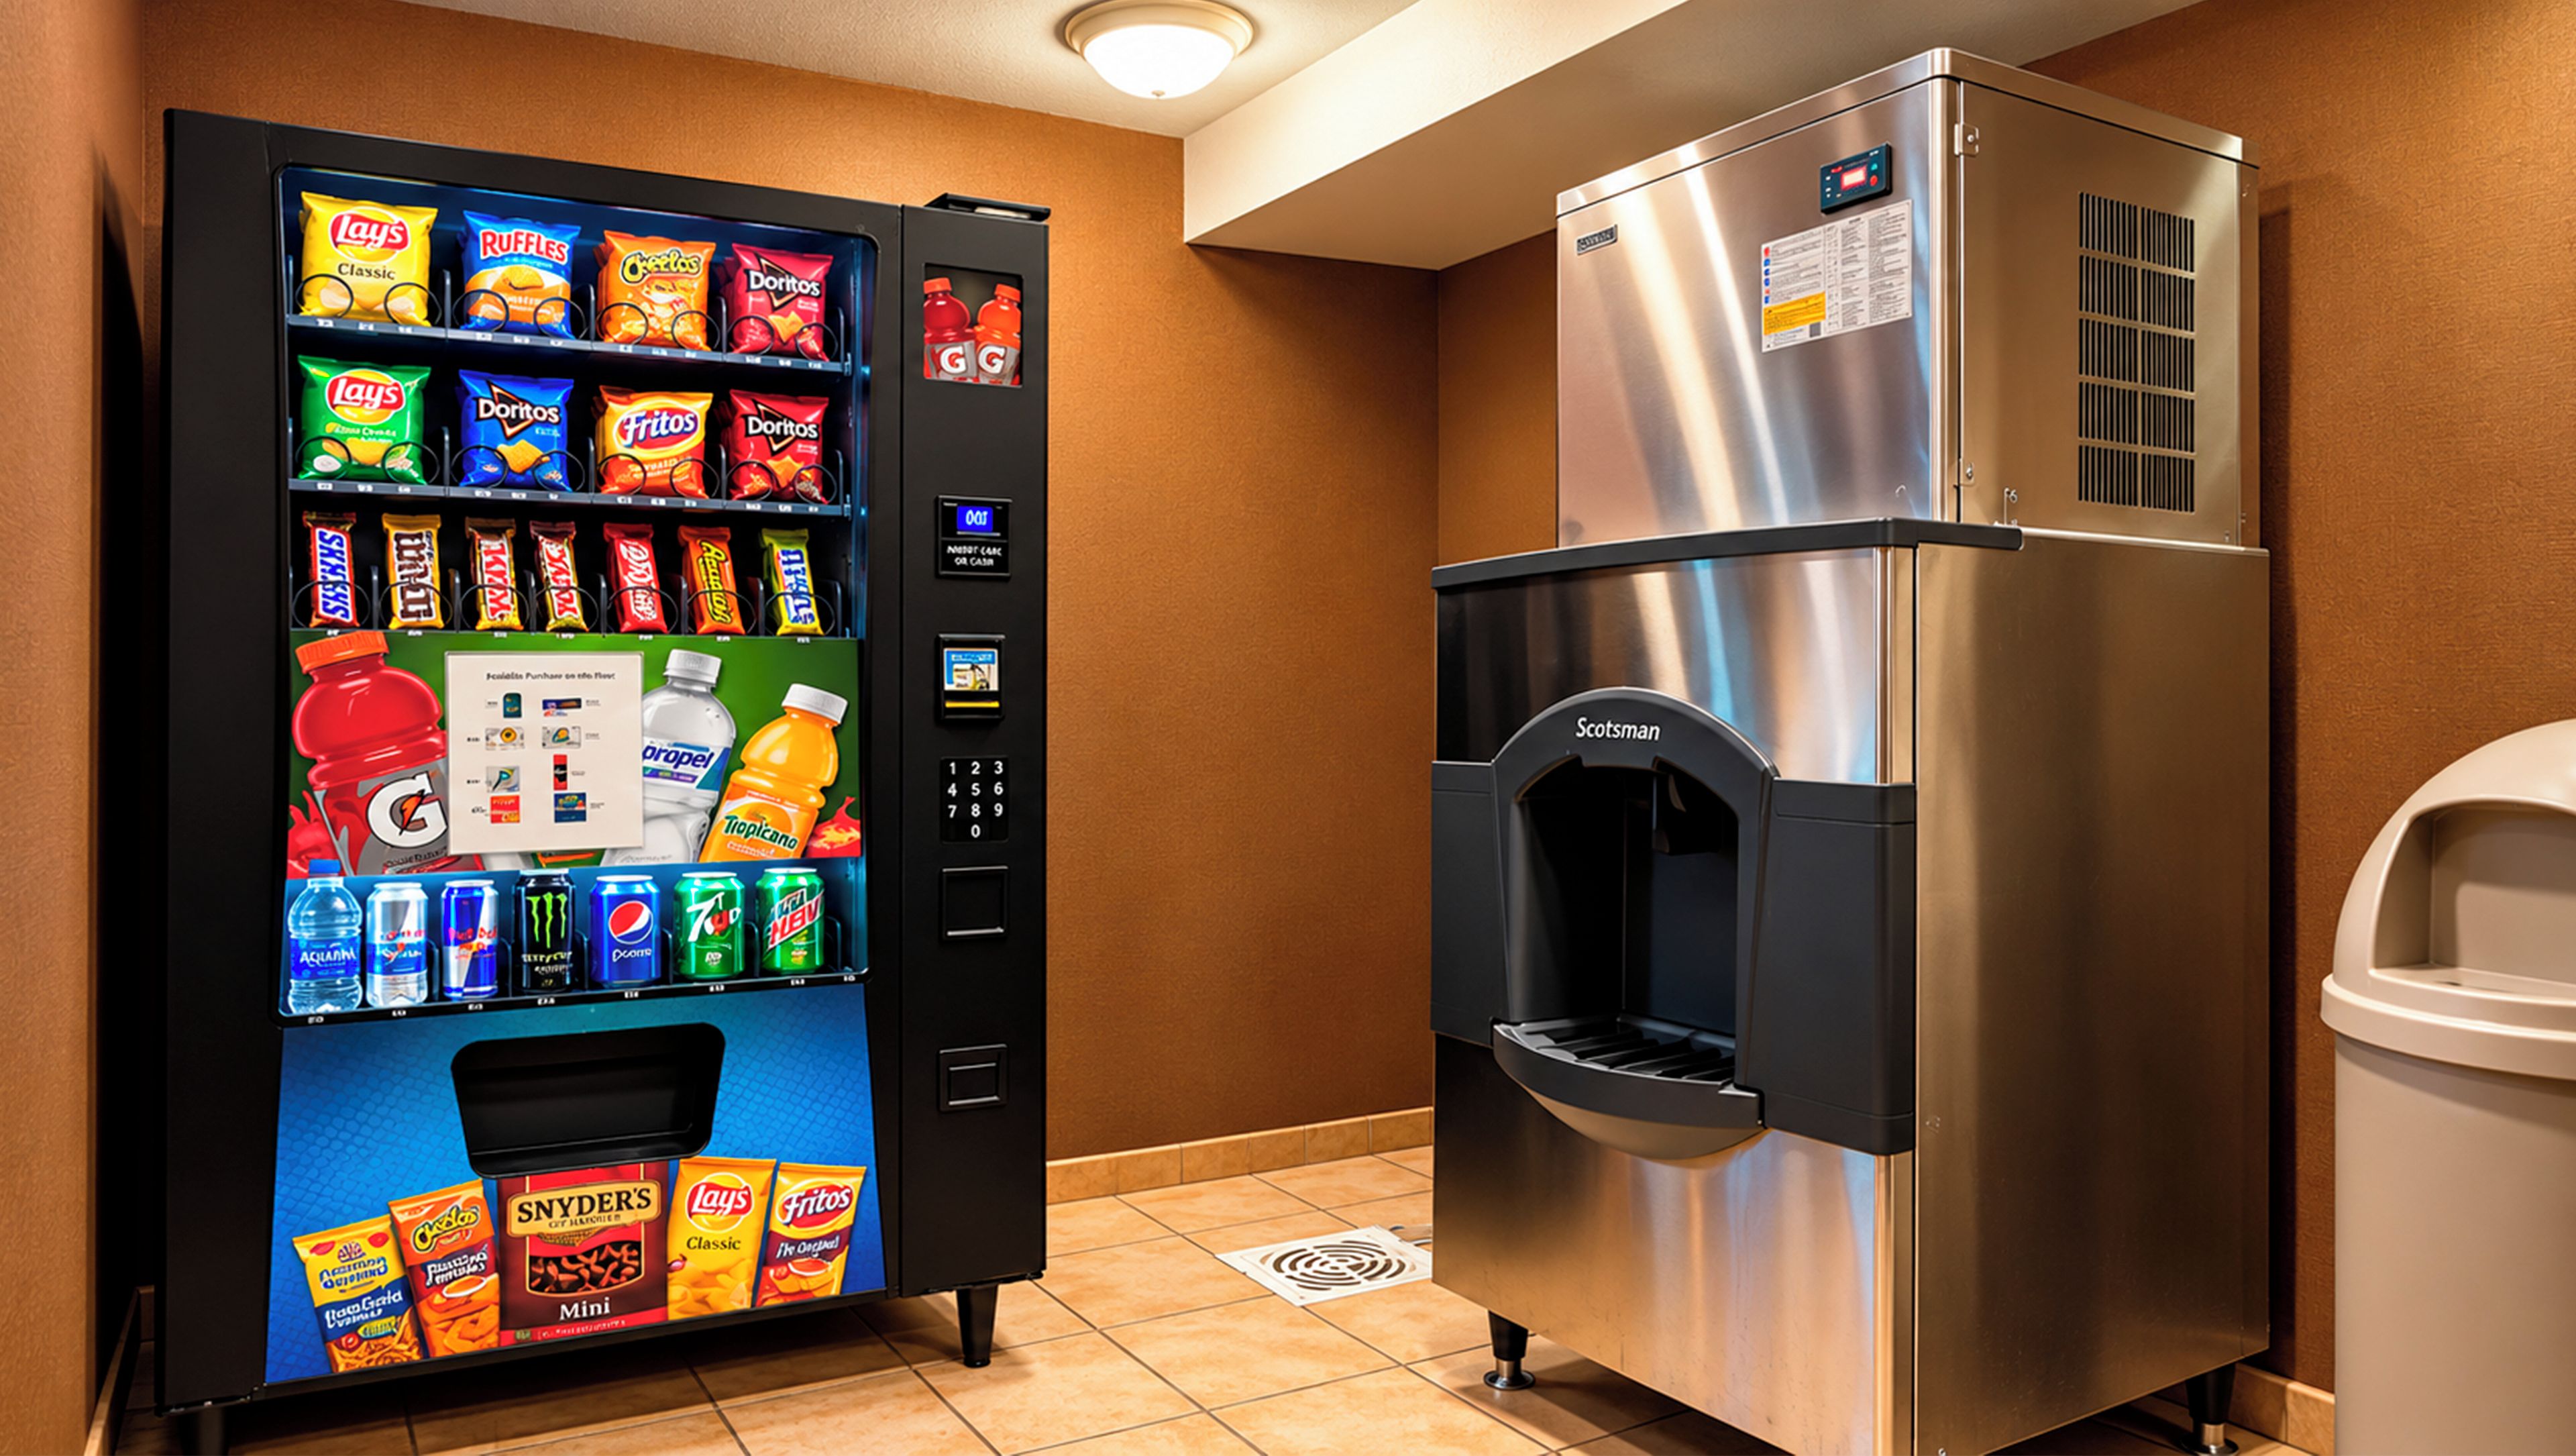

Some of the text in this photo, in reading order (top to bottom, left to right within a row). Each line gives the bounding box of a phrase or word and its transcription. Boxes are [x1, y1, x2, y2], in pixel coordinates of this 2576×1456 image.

[480, 231, 568, 262] RUFFLES
[337, 262, 396, 280] Classic
[749, 271, 821, 296] Doritos
[478, 399, 560, 424] Doritos
[623, 411, 696, 446] Fritos
[747, 416, 819, 438] Doritos
[1575, 717, 1661, 741] Scotsman
[642, 745, 714, 769] propel
[949, 760, 1004, 776] 1 2 3
[947, 781, 1004, 797] 4 5 6
[947, 802, 1004, 819] 7 8 9
[970, 824, 981, 838] 0
[517, 1188, 651, 1223] SNYDER'S
[784, 1186, 851, 1225] Fritos
[686, 1236, 741, 1250] Classic
[559, 1296, 610, 1320] Mini
